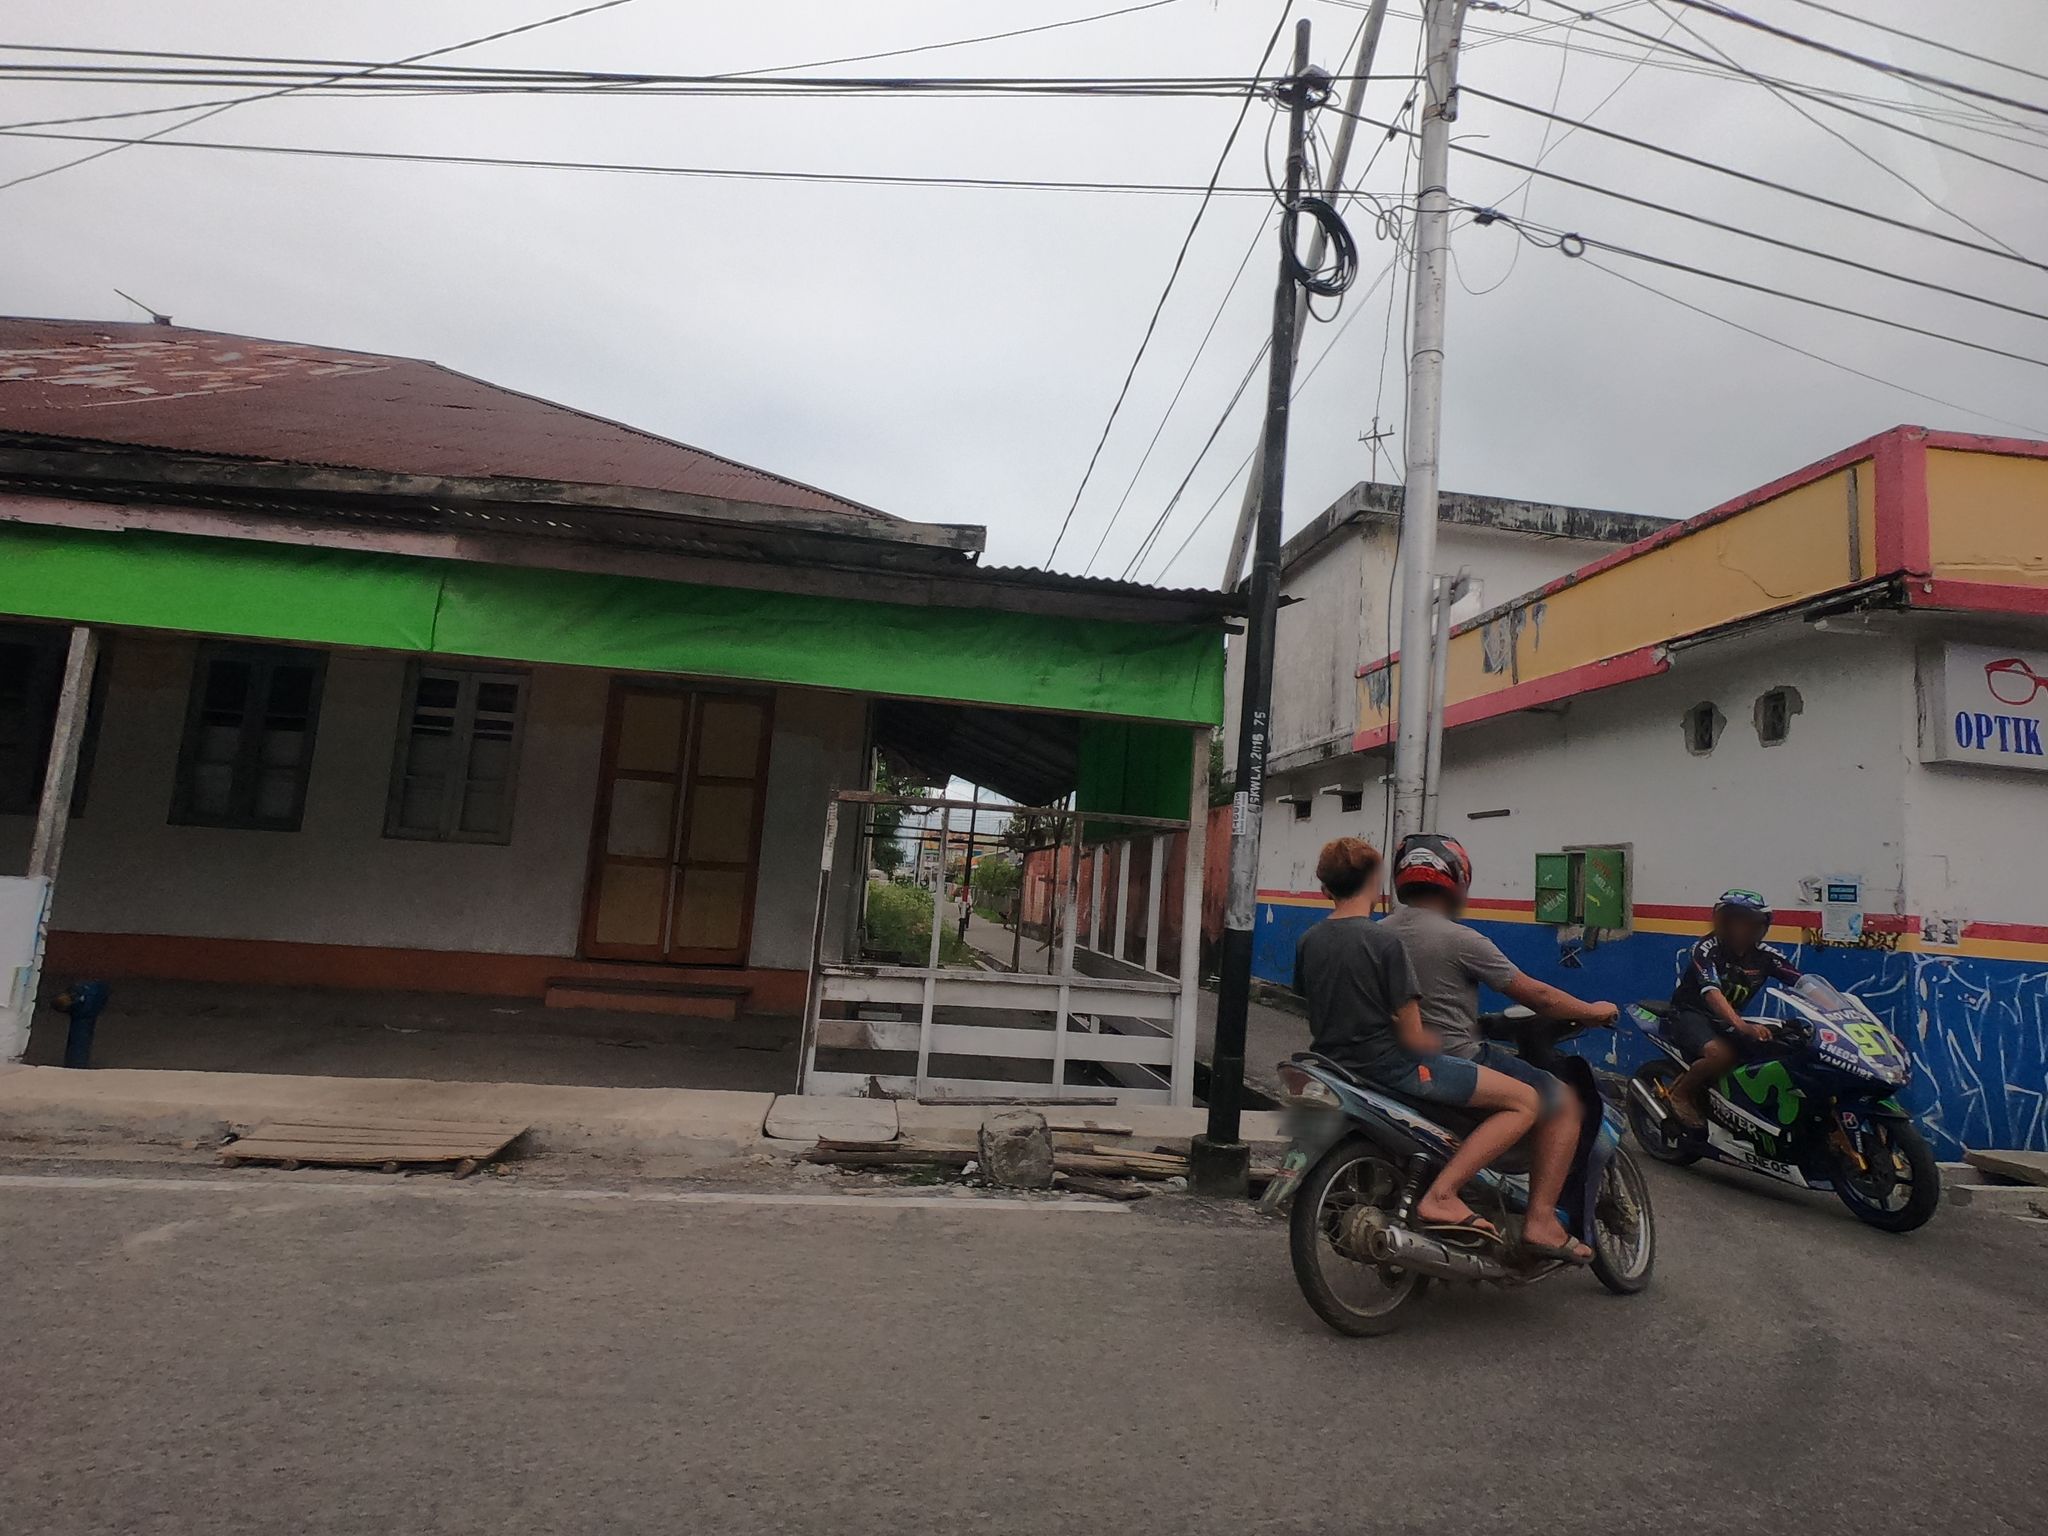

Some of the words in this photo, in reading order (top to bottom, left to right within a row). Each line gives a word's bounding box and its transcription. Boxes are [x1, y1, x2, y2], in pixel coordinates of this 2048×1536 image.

[1253, 711, 1266, 726] 75
[1955, 711, 2043, 755] OPTIK
[1819, 1041, 1858, 1064] ENEOS
[1745, 1153, 1790, 1175] ENEOS
